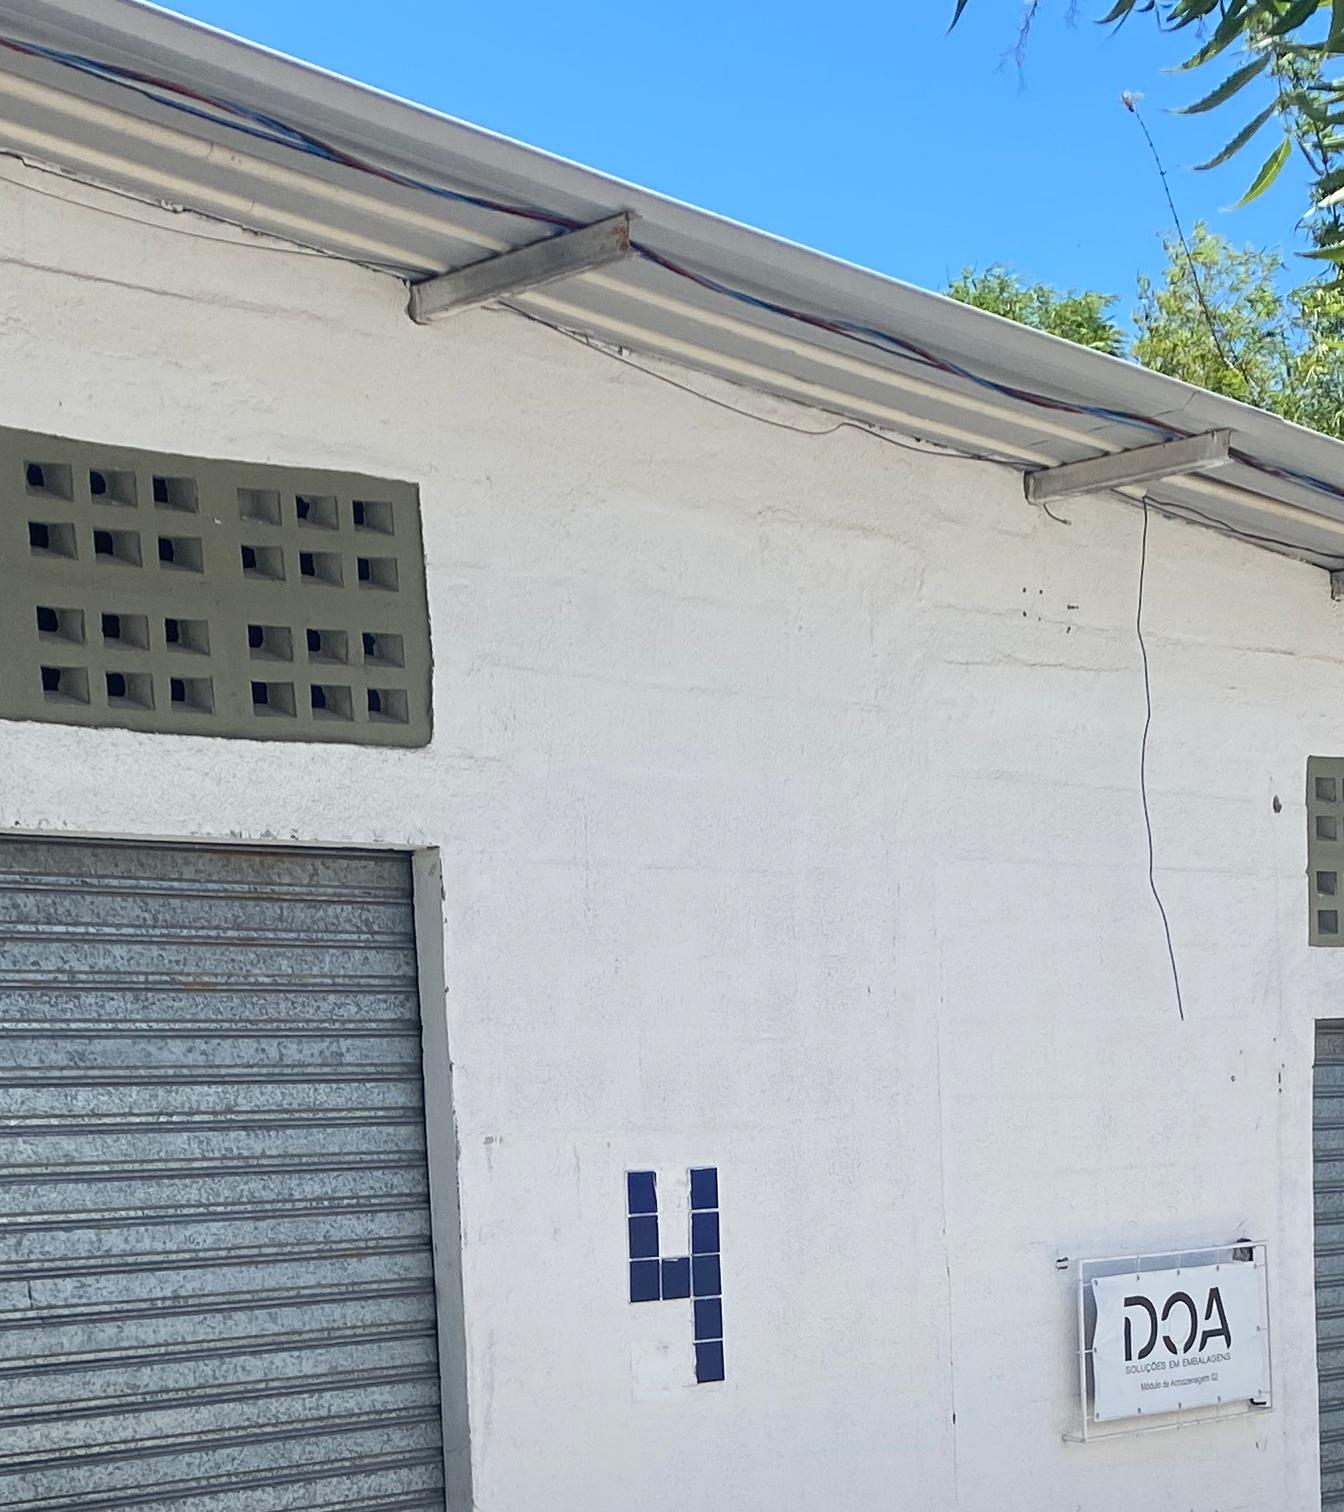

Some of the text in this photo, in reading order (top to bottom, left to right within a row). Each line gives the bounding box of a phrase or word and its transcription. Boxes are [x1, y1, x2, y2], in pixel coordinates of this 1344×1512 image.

[626, 1166, 725, 1384] 4
[1124, 1287, 1231, 1361] DOA
[1125, 1352, 1230, 1374] SOLUÇÕES EM EMBALAGENS
